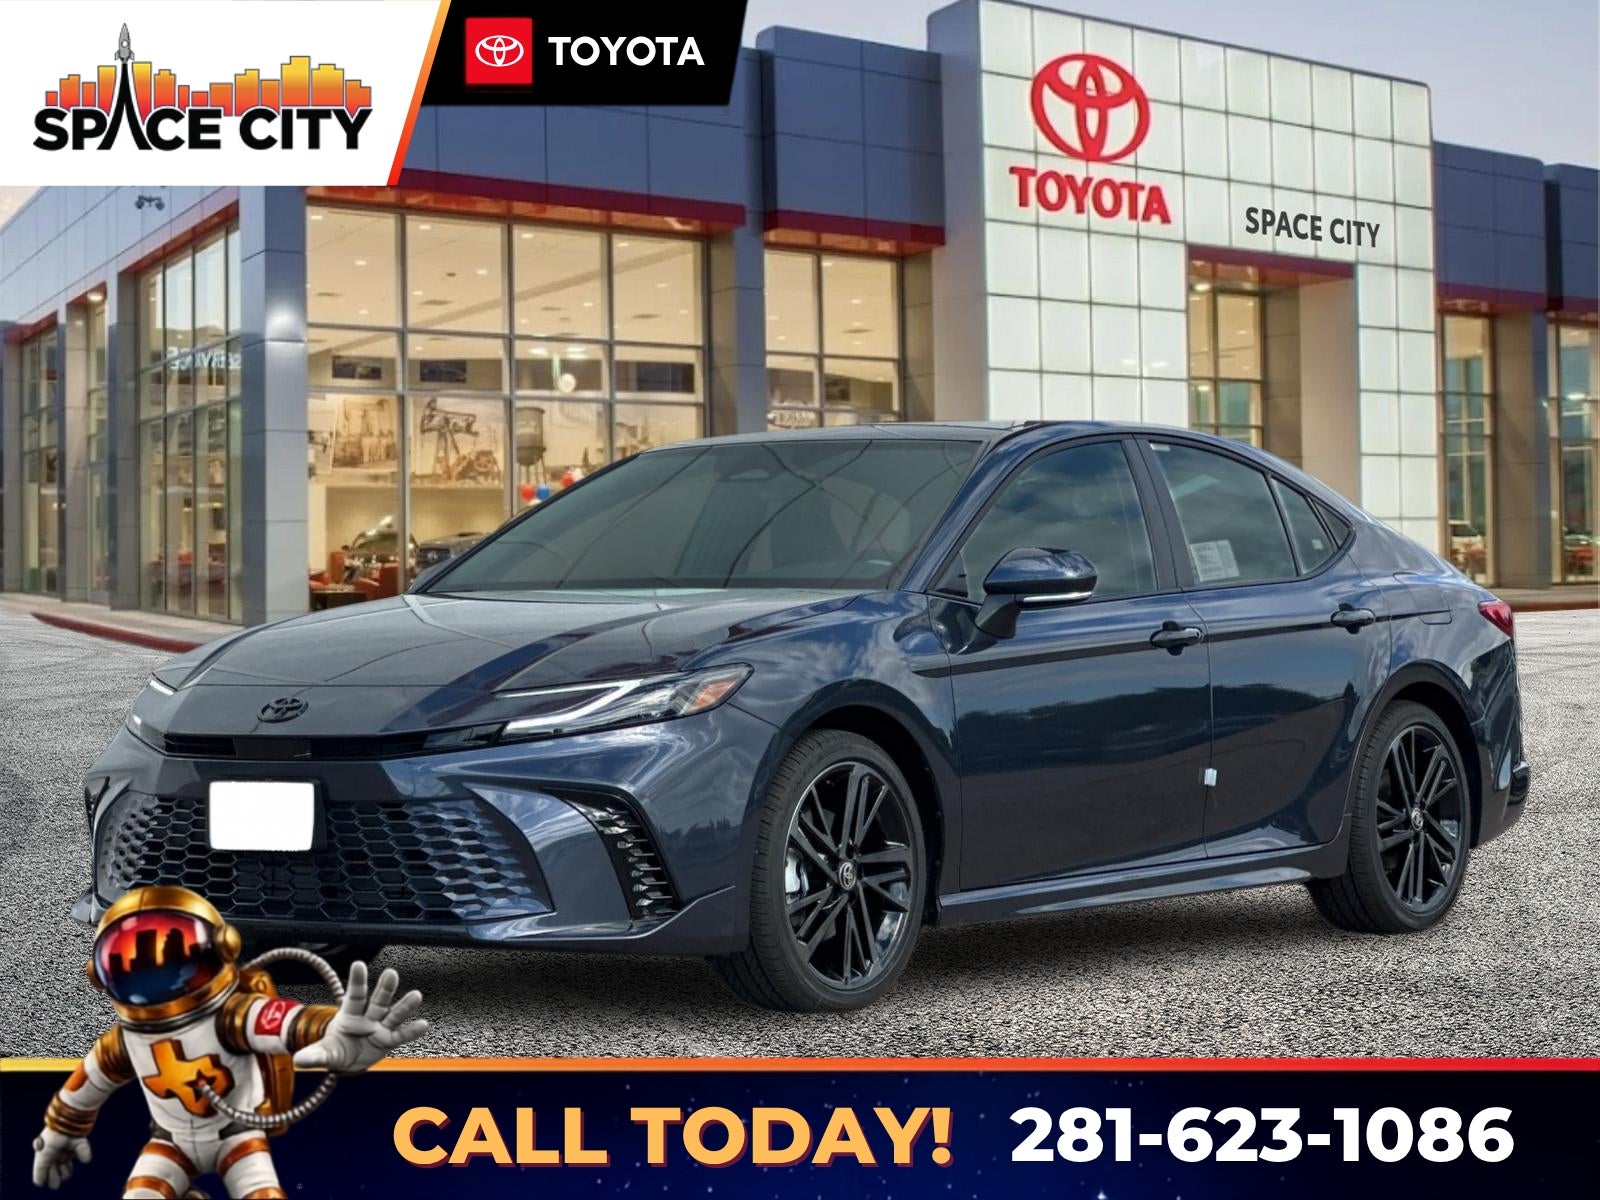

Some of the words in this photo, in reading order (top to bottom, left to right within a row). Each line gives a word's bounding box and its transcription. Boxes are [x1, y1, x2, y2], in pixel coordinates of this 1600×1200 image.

[1009, 166, 1171, 224] TOYOTA
[1245, 207, 1322, 241] SPACE
[1329, 218, 1380, 248] CITY
